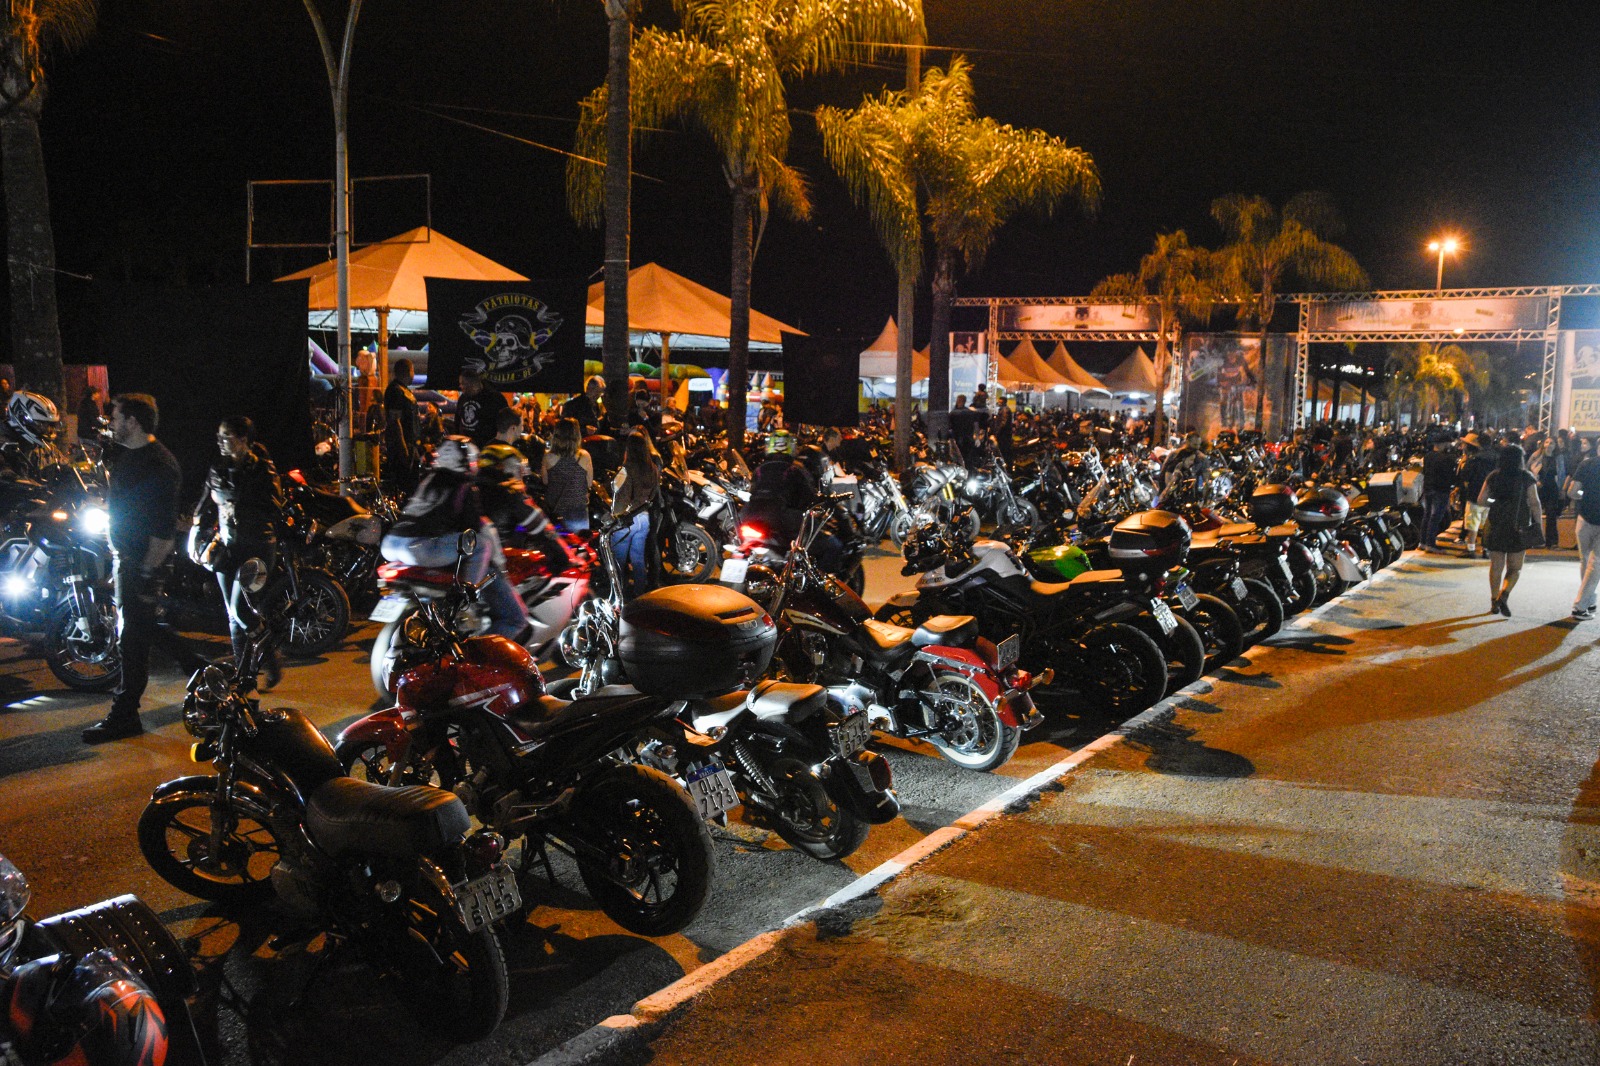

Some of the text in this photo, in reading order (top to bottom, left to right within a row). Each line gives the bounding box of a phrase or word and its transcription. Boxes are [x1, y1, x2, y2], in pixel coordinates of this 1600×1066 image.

[483, 295, 540, 311] PATRIOTAS
[698, 773, 725, 796] QLA
[700, 787, 734, 815] 7173
[470, 876, 507, 910] JHF
[471, 892, 516, 926] 6153
